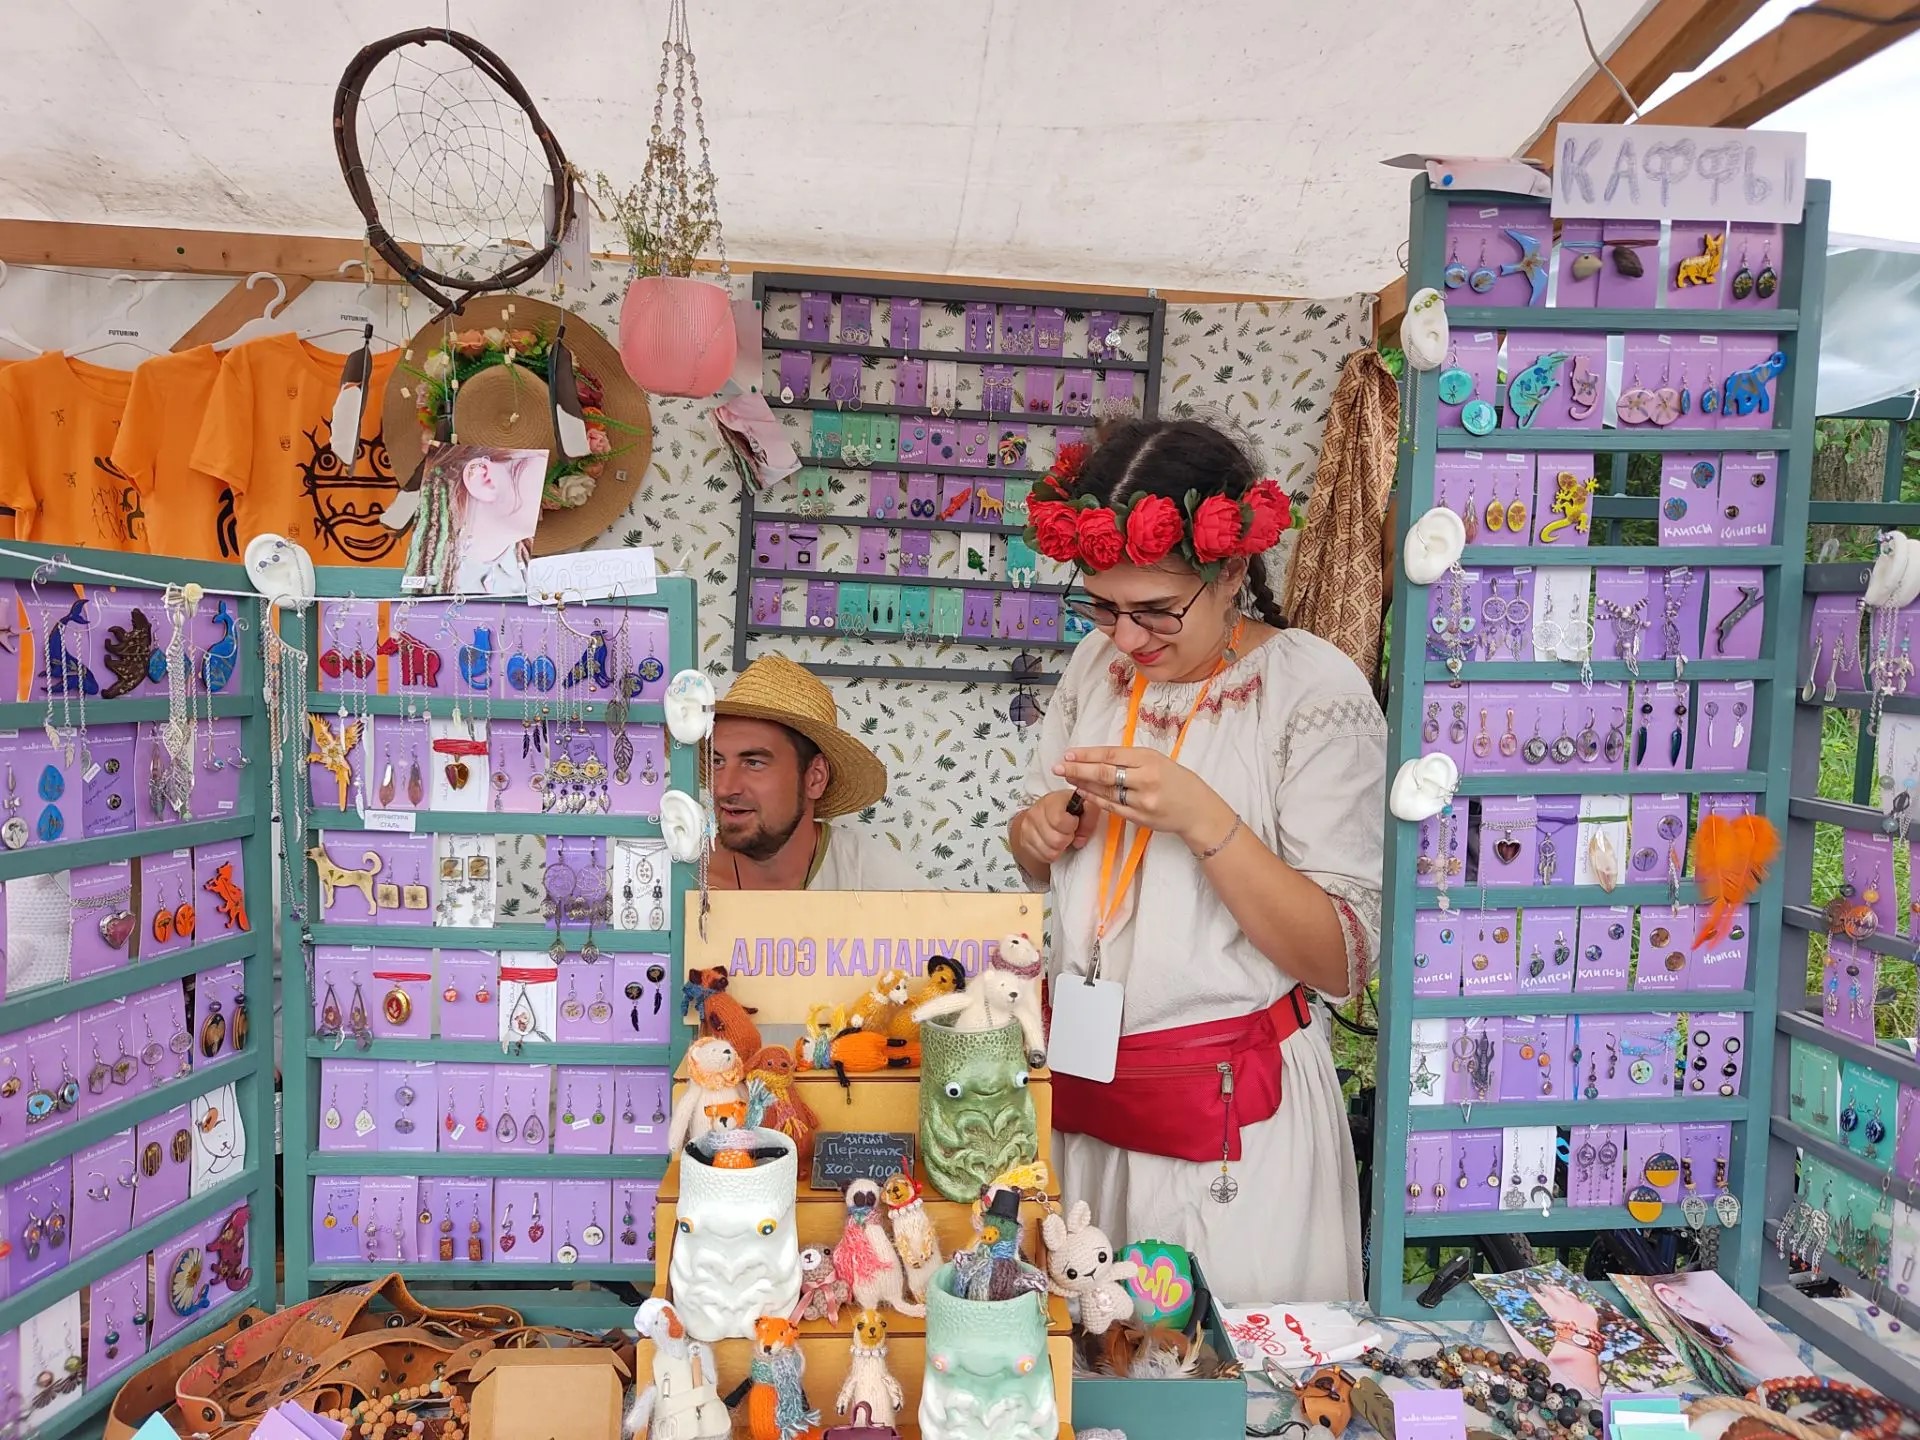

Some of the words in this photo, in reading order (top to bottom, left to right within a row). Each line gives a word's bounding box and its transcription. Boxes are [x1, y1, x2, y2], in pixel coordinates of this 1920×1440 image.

[1561, 137, 1796, 207] КАФФЫ
[729, 937, 816, 976] АЛОЭ
[828, 1142, 904, 1159] Персонаж
